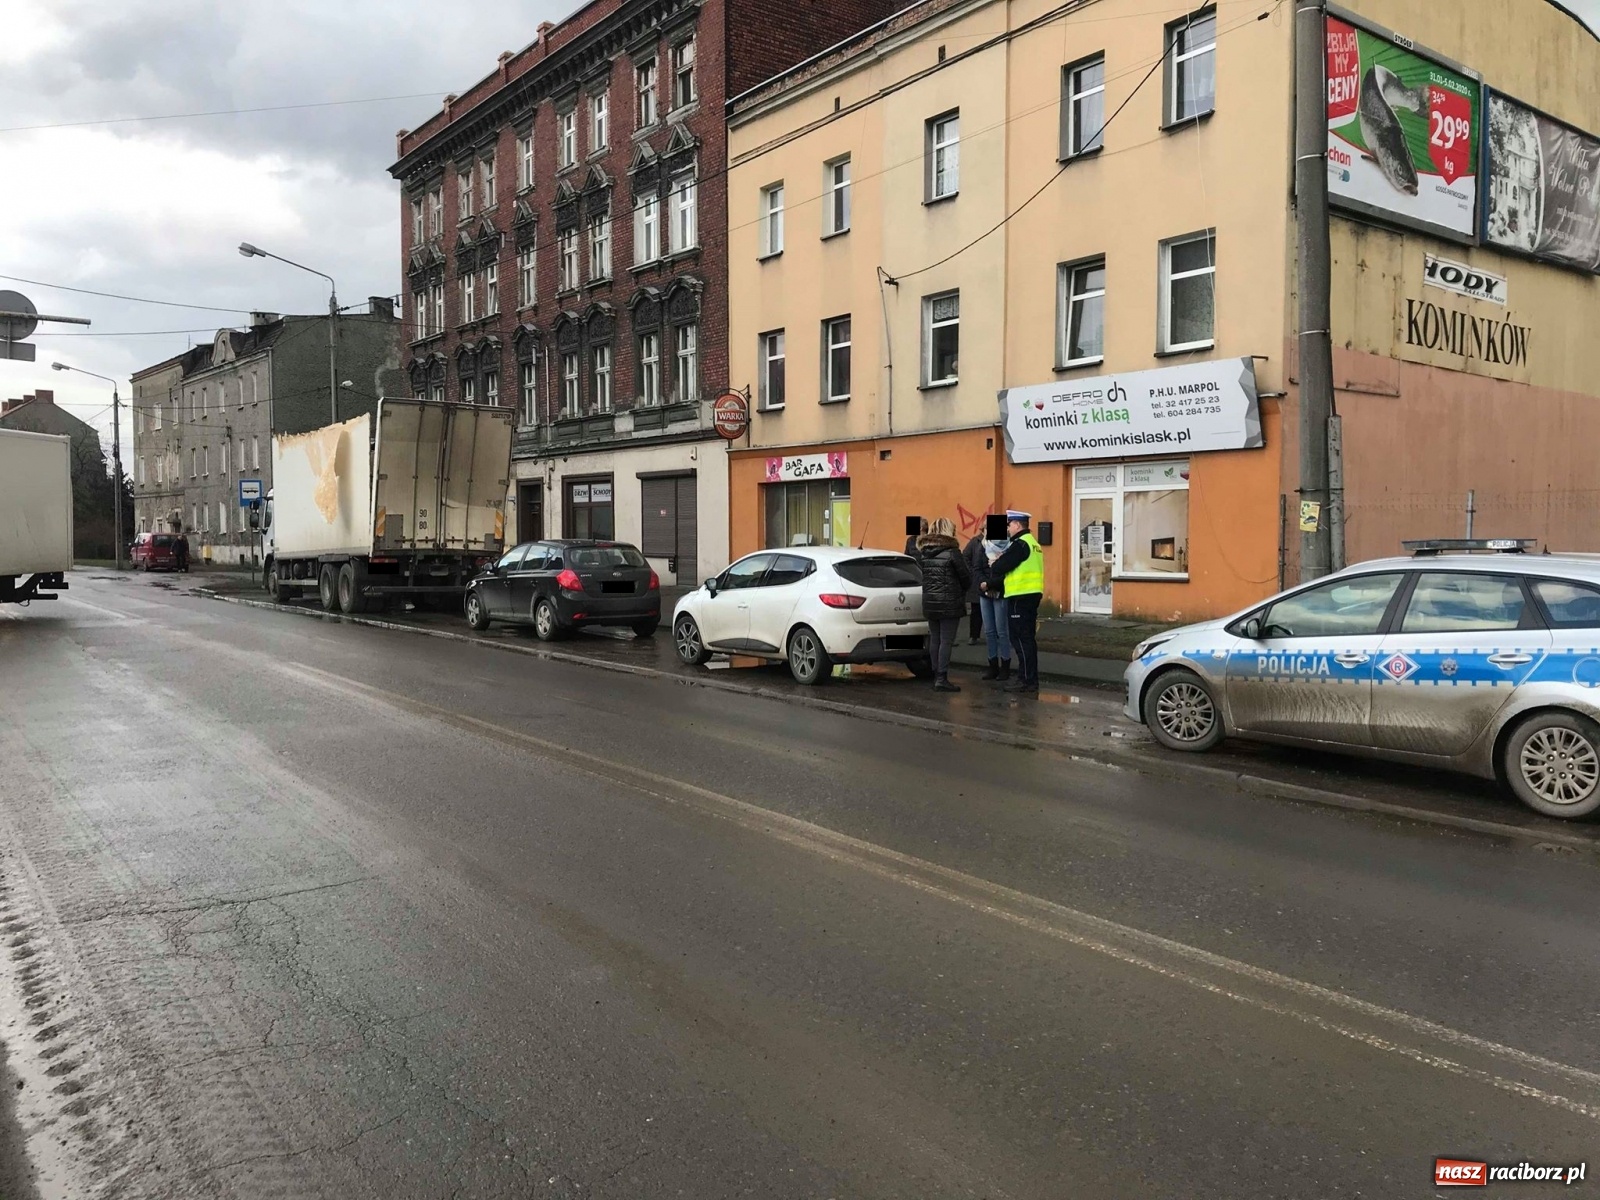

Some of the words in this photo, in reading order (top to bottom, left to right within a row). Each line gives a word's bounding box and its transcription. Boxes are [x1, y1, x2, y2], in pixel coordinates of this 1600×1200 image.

[1334, 53, 1350, 73] MY
[1444, 156, 1454, 175] kg
[1405, 298, 1532, 368] KOMINKÓW
[1052, 389, 1103, 403] DEFRO
[1149, 386, 1177, 398] P.H.U.
[1179, 382, 1220, 395] MARPOL
[1072, 399, 1104, 407] HOME
[1165, 400, 1176, 408] 32
[1178, 398, 1192, 406] 417
[1208, 395, 1220, 403] 23
[718, 412, 744, 421] WARKA
[1025, 410, 1078, 429] kominki
[1081, 412, 1089, 424] z
[1091, 407, 1130, 424] klasą
[1153, 411, 1166, 419] tel.
[1167, 409, 1184, 417] 604
[1186, 407, 1202, 415] 284
[1204, 405, 1221, 413] 735
[1044, 428, 1191, 451] www.kominkislask.pl
[785, 459, 803, 471] BAR
[794, 463, 824, 477] GAFA
[419, 509, 428, 518] 90
[419, 521, 428, 530] 80
[1492, 540, 1518, 548] POLICJA
[1257, 655, 1330, 675] POLICJA
[1393, 661, 1402, 673] R
